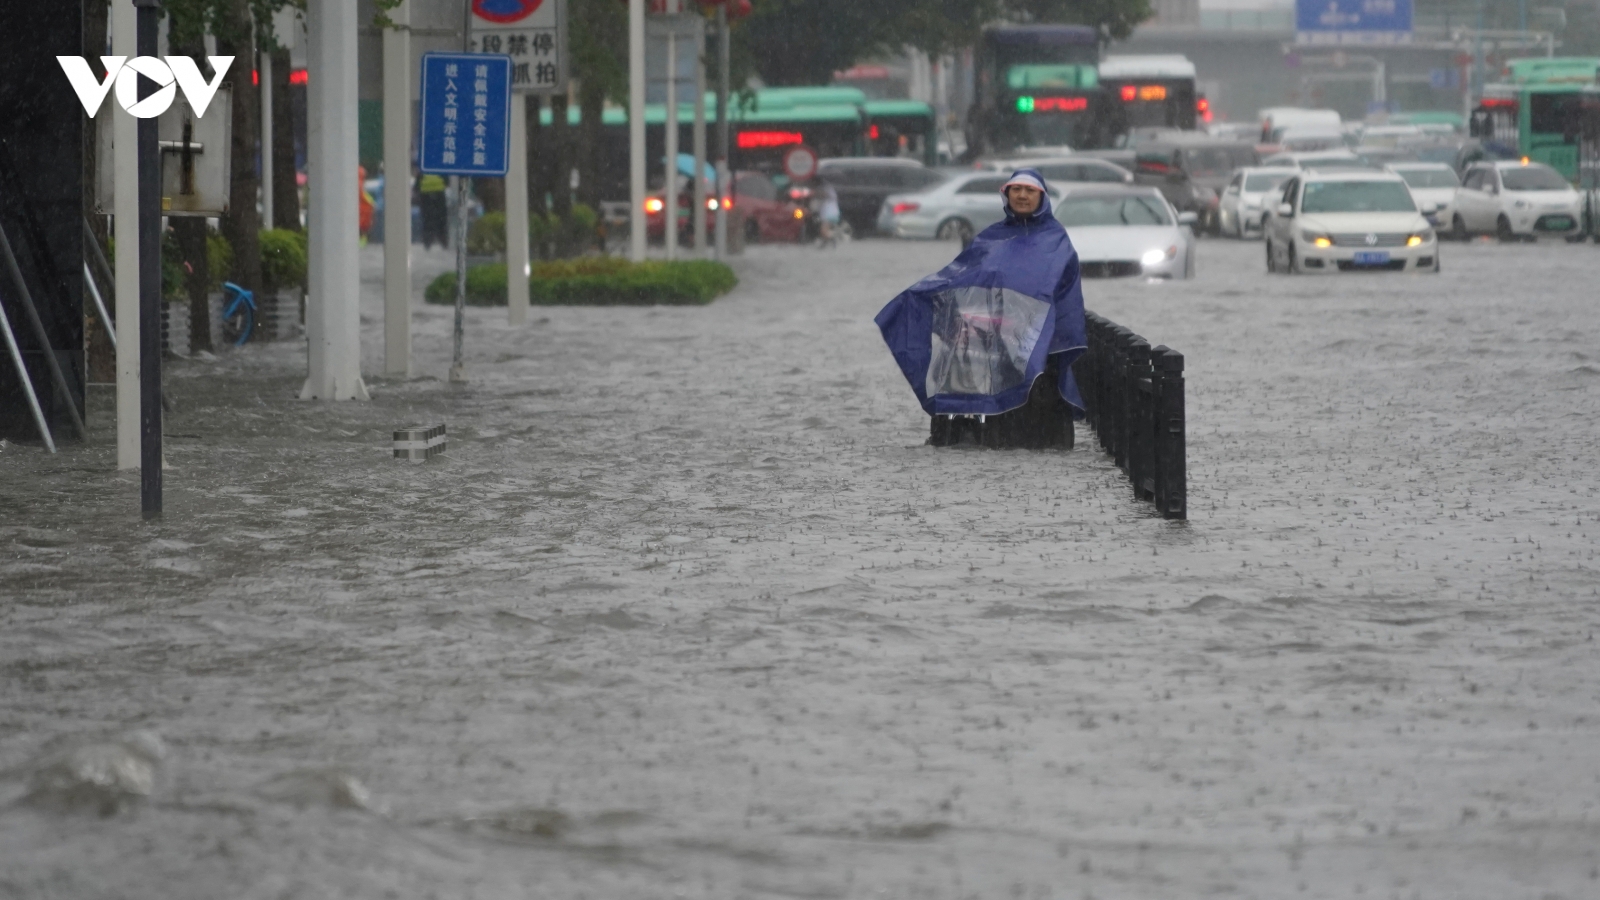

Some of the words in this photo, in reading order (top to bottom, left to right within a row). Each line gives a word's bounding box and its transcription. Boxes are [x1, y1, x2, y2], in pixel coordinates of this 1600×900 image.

[471, 33, 554, 56] 段禁停
[443, 63, 458, 165] 进入文明示范路
[473, 64, 488, 166] 请佩戴安全头盔
